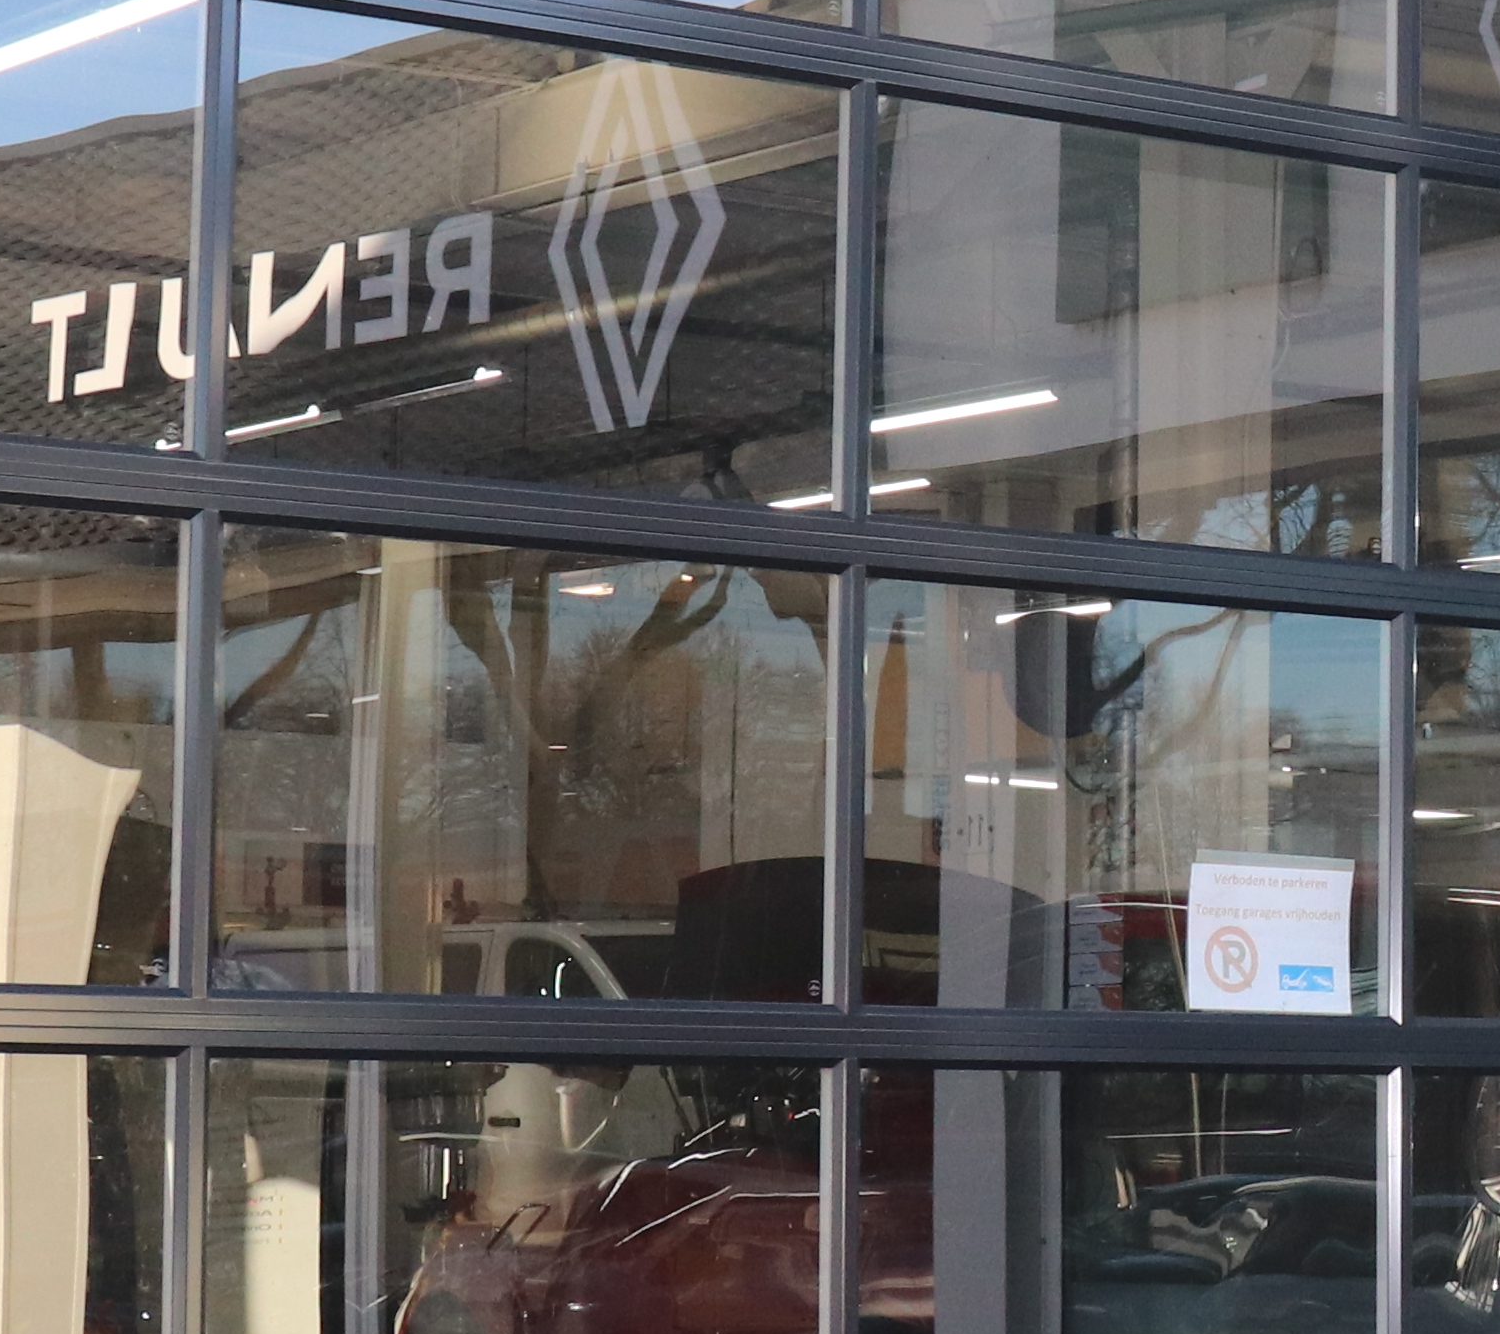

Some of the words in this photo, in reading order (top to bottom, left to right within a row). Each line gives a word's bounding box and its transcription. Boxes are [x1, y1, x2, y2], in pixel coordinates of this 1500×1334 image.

[1214, 872, 1266, 886] Verboden
[1268, 876, 1279, 887] te
[1281, 877, 1329, 889] parkeren
[1194, 902, 1241, 919] Toegang
[1241, 907, 1282, 920] garages
[1285, 908, 1341, 921] vrijhouden
